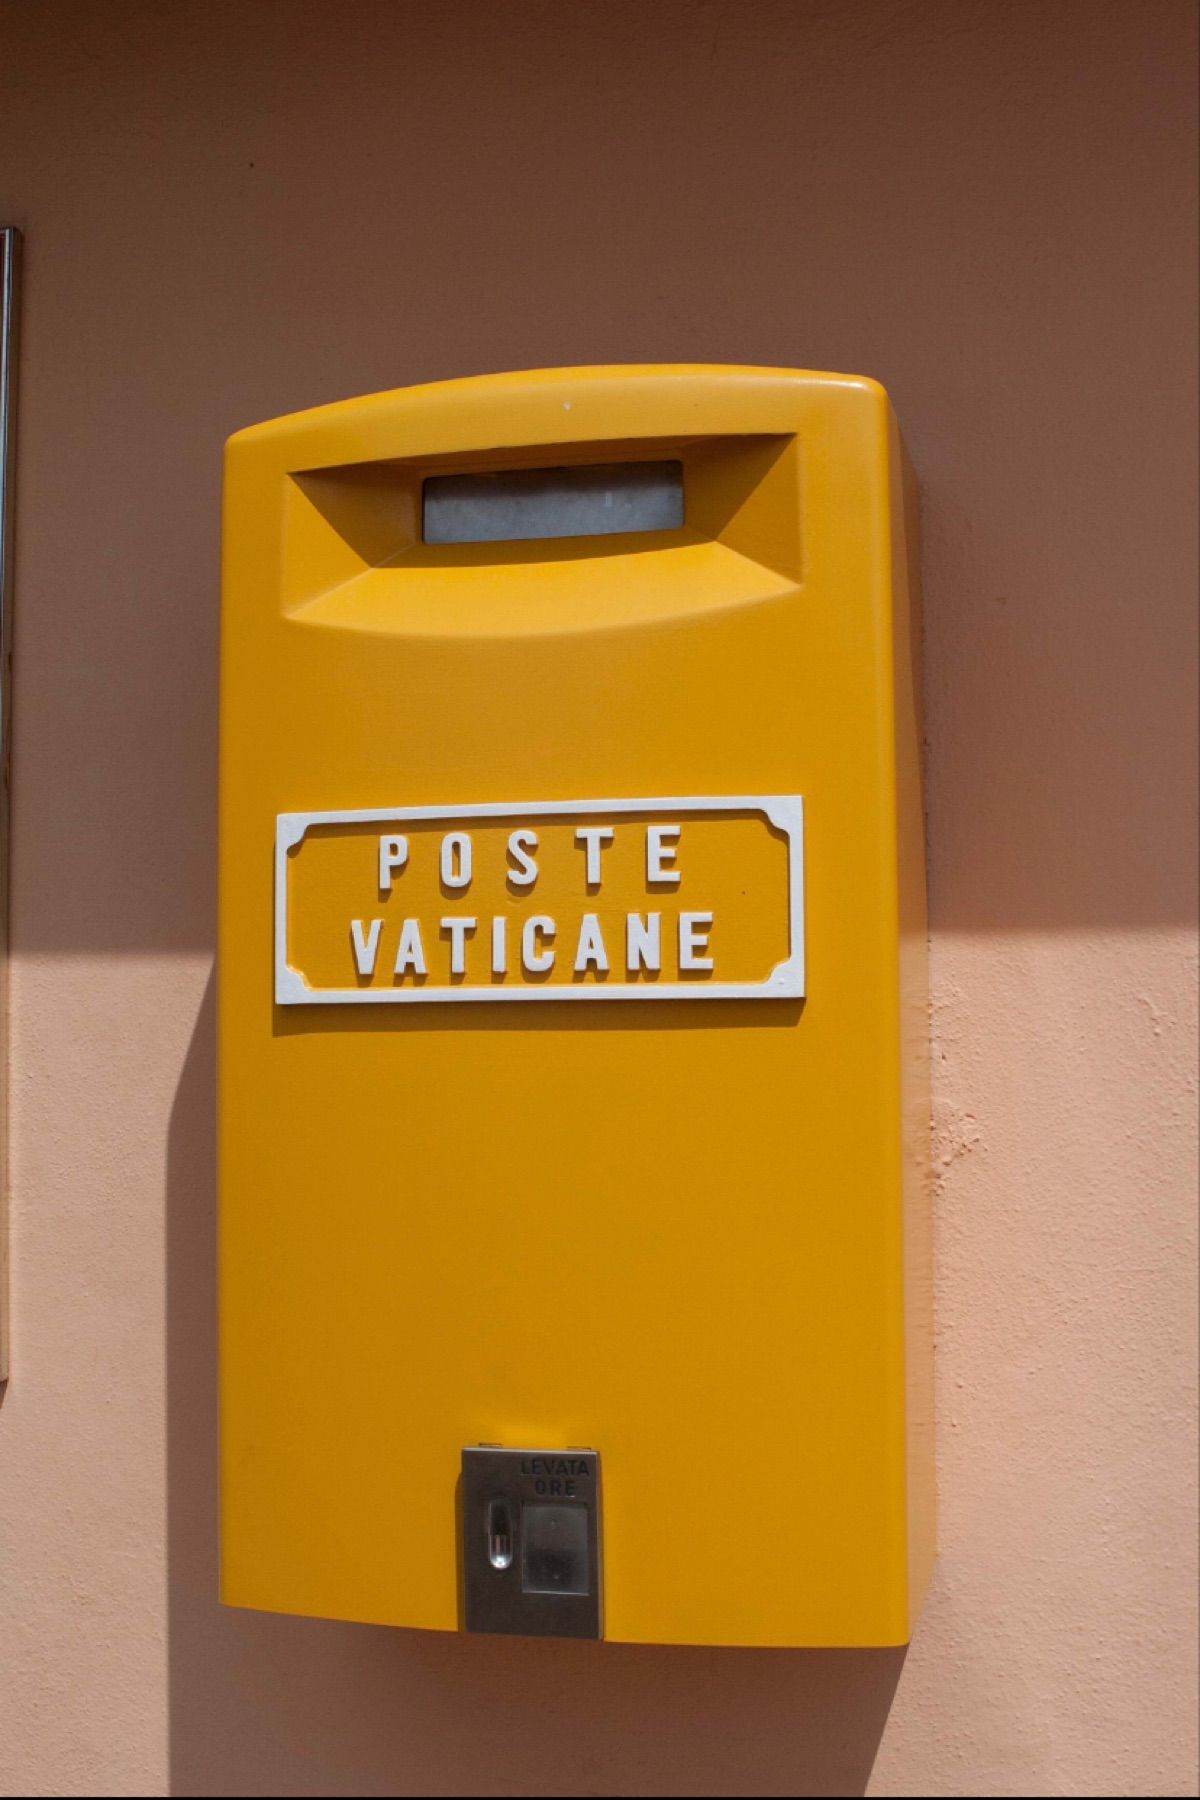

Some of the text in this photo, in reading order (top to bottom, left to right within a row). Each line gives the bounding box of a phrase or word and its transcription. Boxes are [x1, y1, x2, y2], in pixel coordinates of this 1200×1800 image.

[379, 825, 681, 889] POSTE
[350, 912, 714, 975] VATICANE
[520, 1458, 590, 1476] LEVATA
[535, 1479, 576, 1497] ORE
